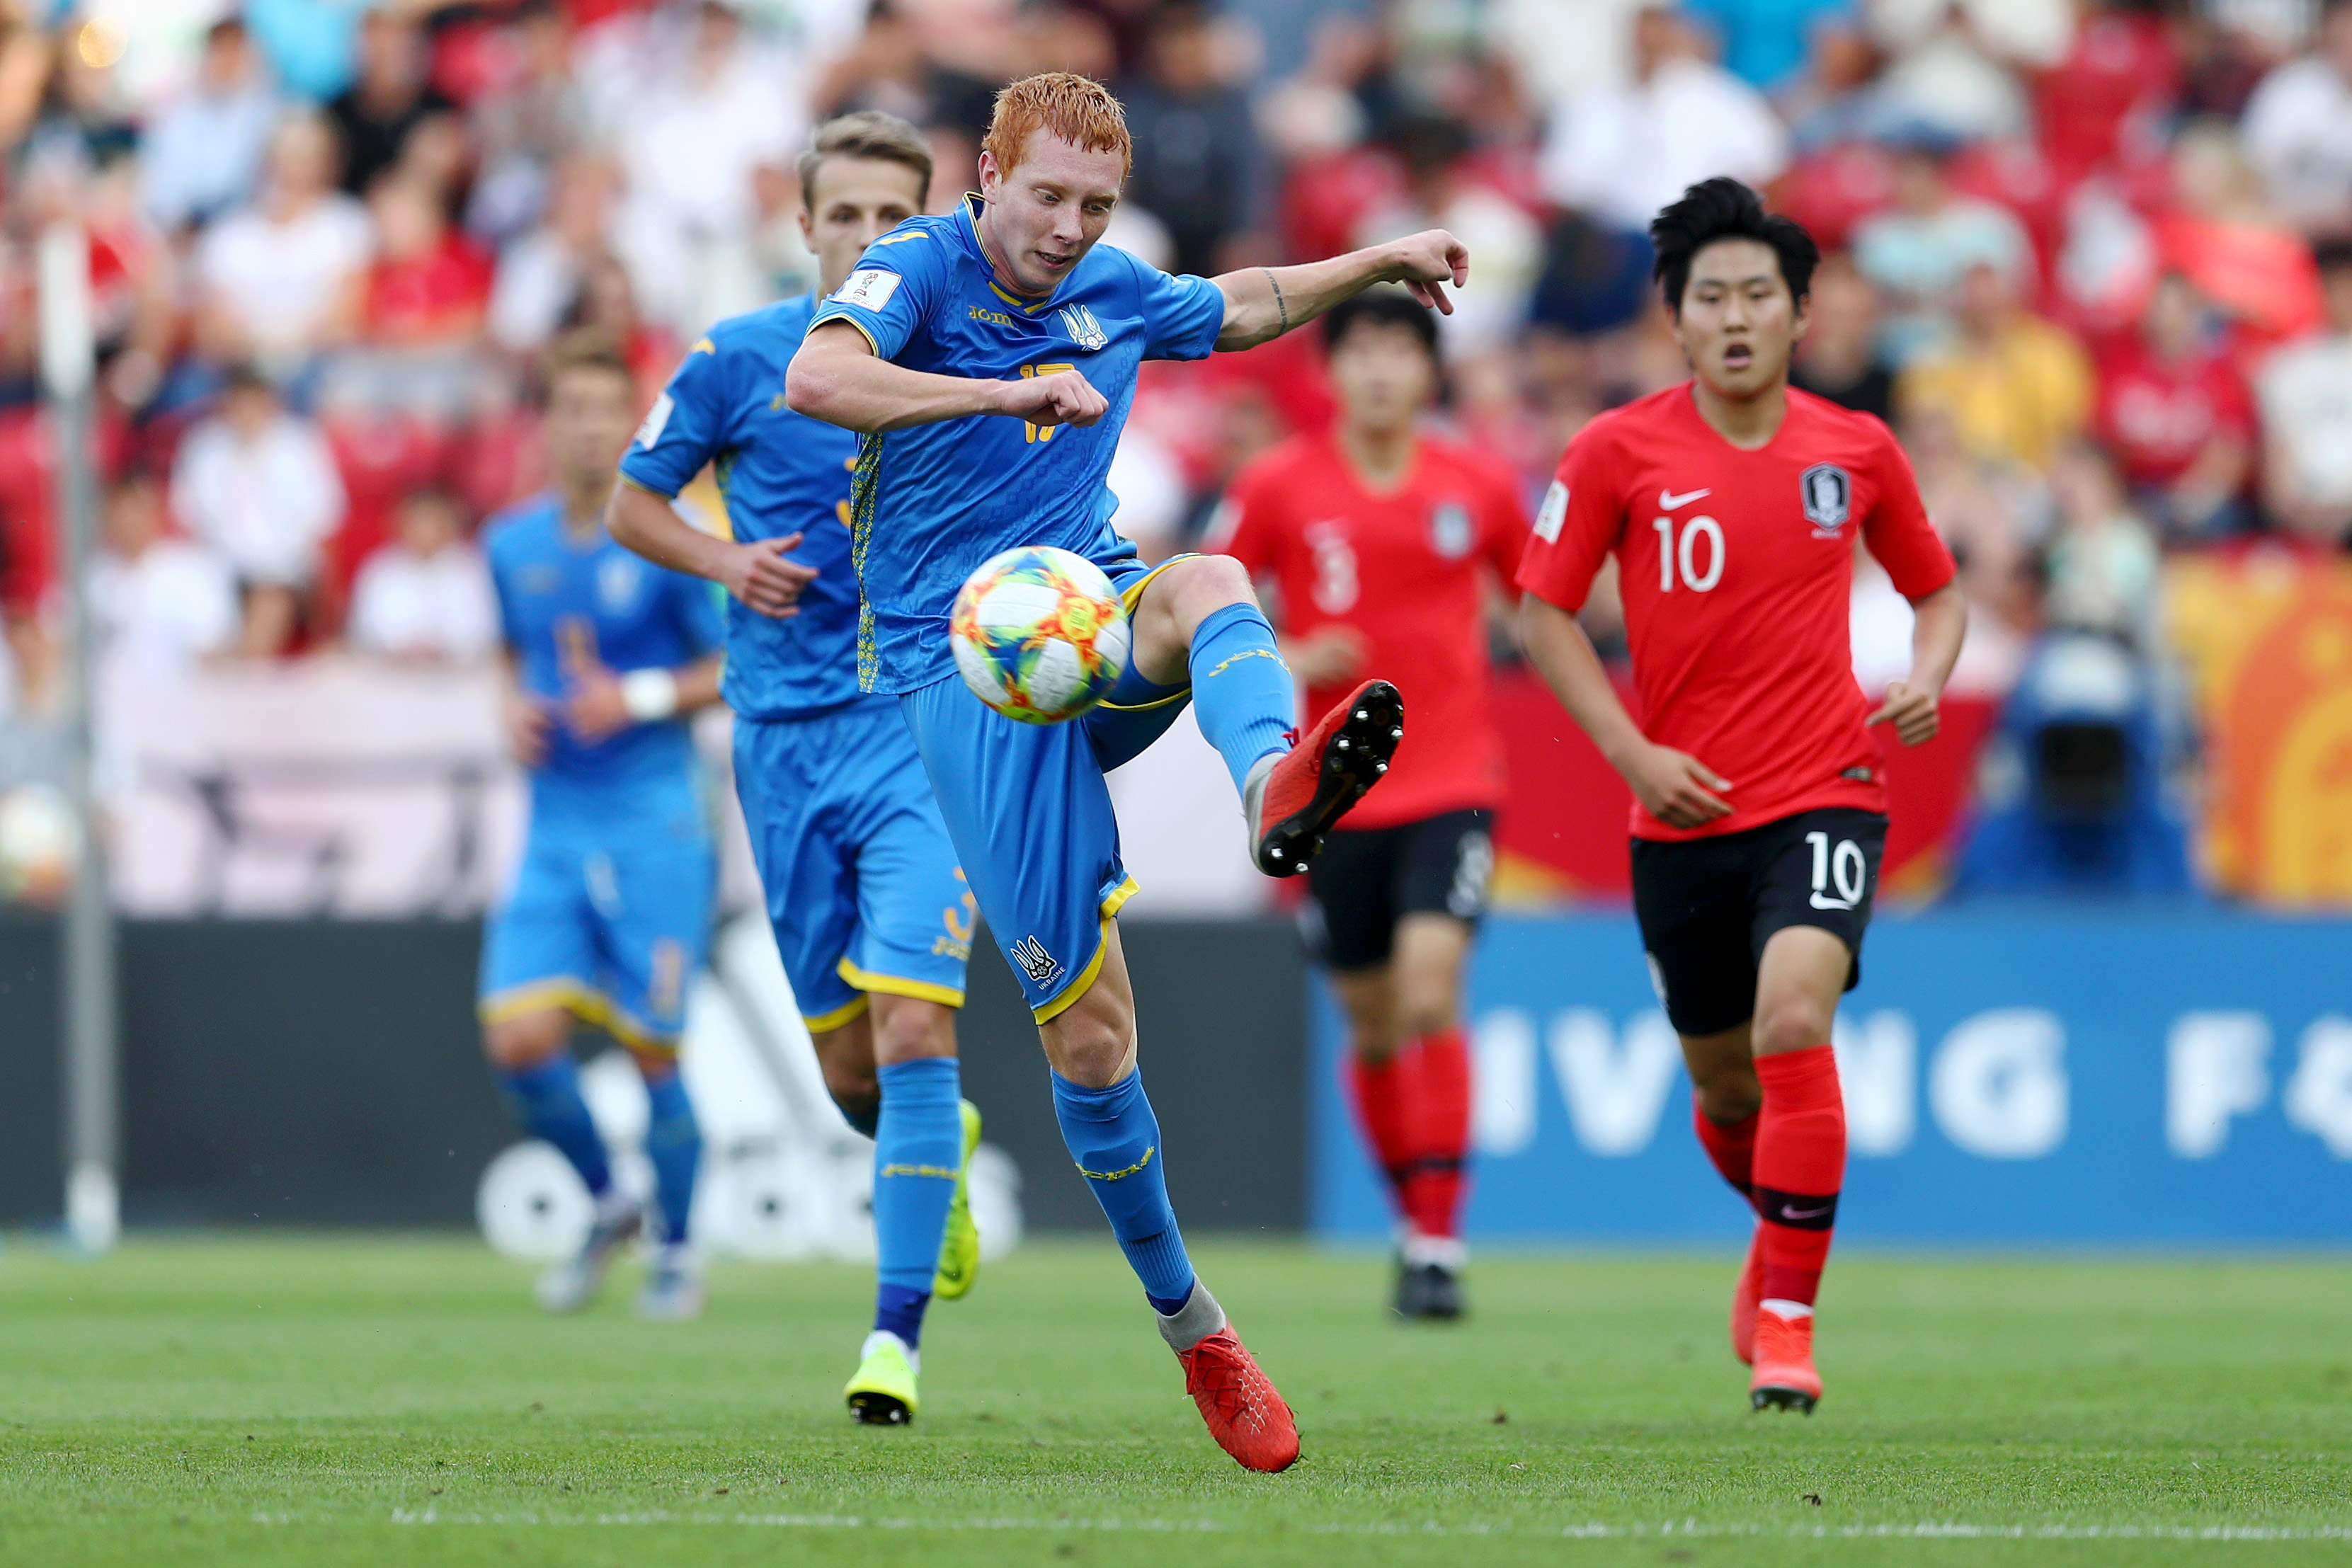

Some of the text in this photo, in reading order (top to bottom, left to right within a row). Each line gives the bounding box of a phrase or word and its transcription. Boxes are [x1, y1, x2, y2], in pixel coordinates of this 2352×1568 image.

[1652, 515, 1725, 593] 10
[1805, 830, 1867, 906] 10
[1038, 966, 1066, 990] UKRAINE
